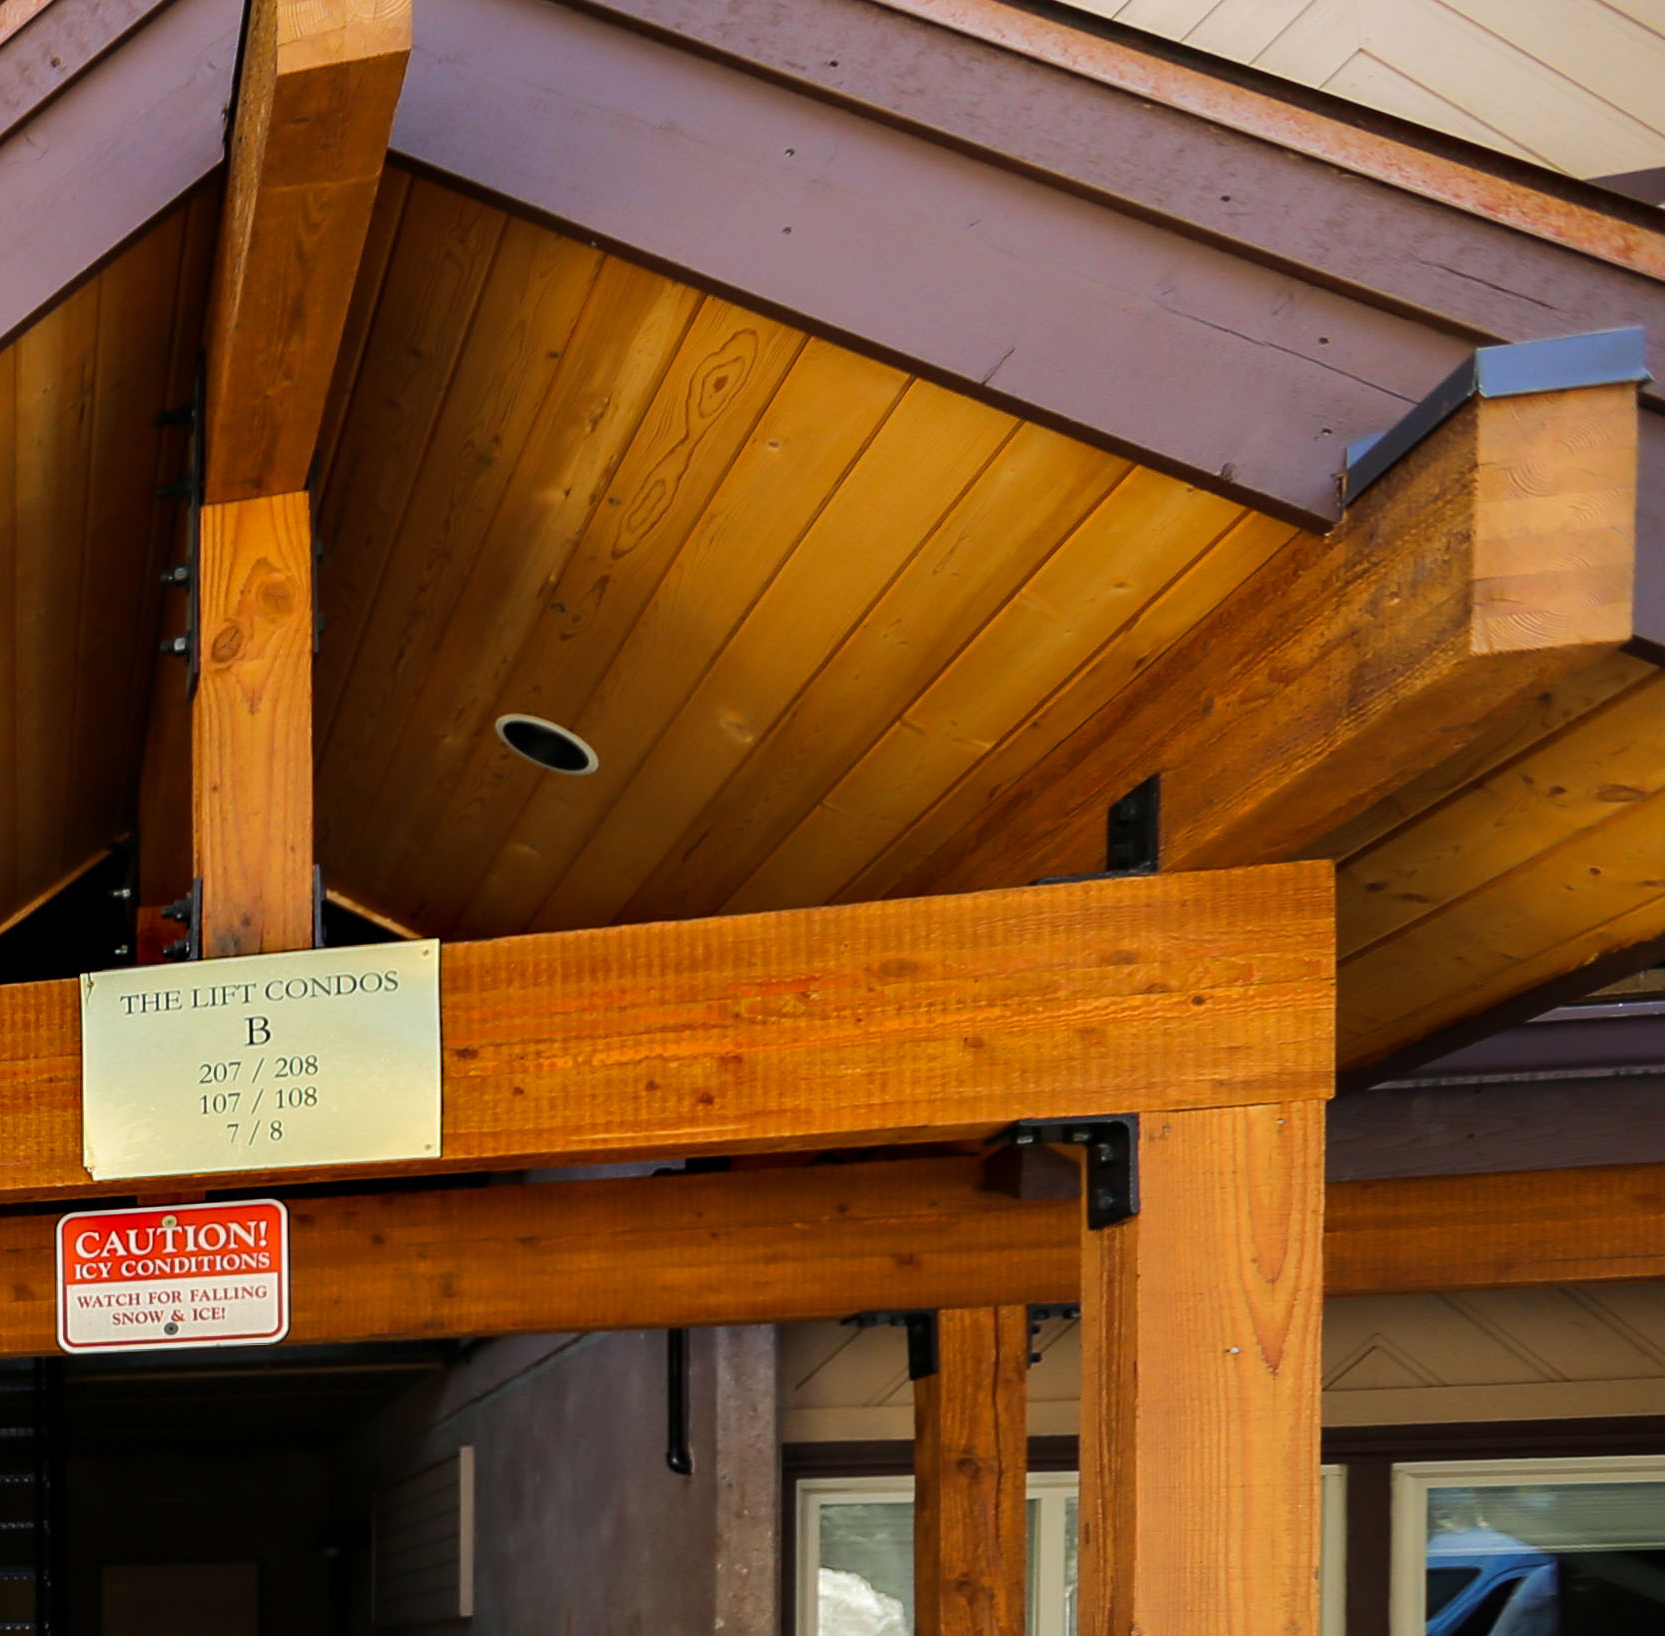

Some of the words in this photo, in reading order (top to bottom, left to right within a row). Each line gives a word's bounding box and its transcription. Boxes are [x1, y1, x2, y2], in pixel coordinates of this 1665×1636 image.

[120, 990, 182, 1015] THE
[191, 983, 257, 1009] LIFT
[265, 970, 399, 1001] CONDOS
[244, 1015, 272, 1046] B
[198, 1061, 242, 1084] 207
[274, 1055, 318, 1078] 208
[199, 1092, 241, 1114] 107
[275, 1086, 318, 1109] 108
[226, 1123, 239, 1143] 7
[270, 1120, 283, 1141] 8
[75, 1220, 268, 1259] CAUTION!
[74, 1262, 113, 1279] ICY
[121, 1252, 271, 1277] CONDITIONS
[77, 1293, 141, 1309] WATCH
[148, 1290, 182, 1305] FOR
[190, 1285, 268, 1303] FALLING
[112, 1310, 165, 1326] SNOW
[171, 1309, 185, 1322] &
[193, 1307, 226, 1321] ICE!
